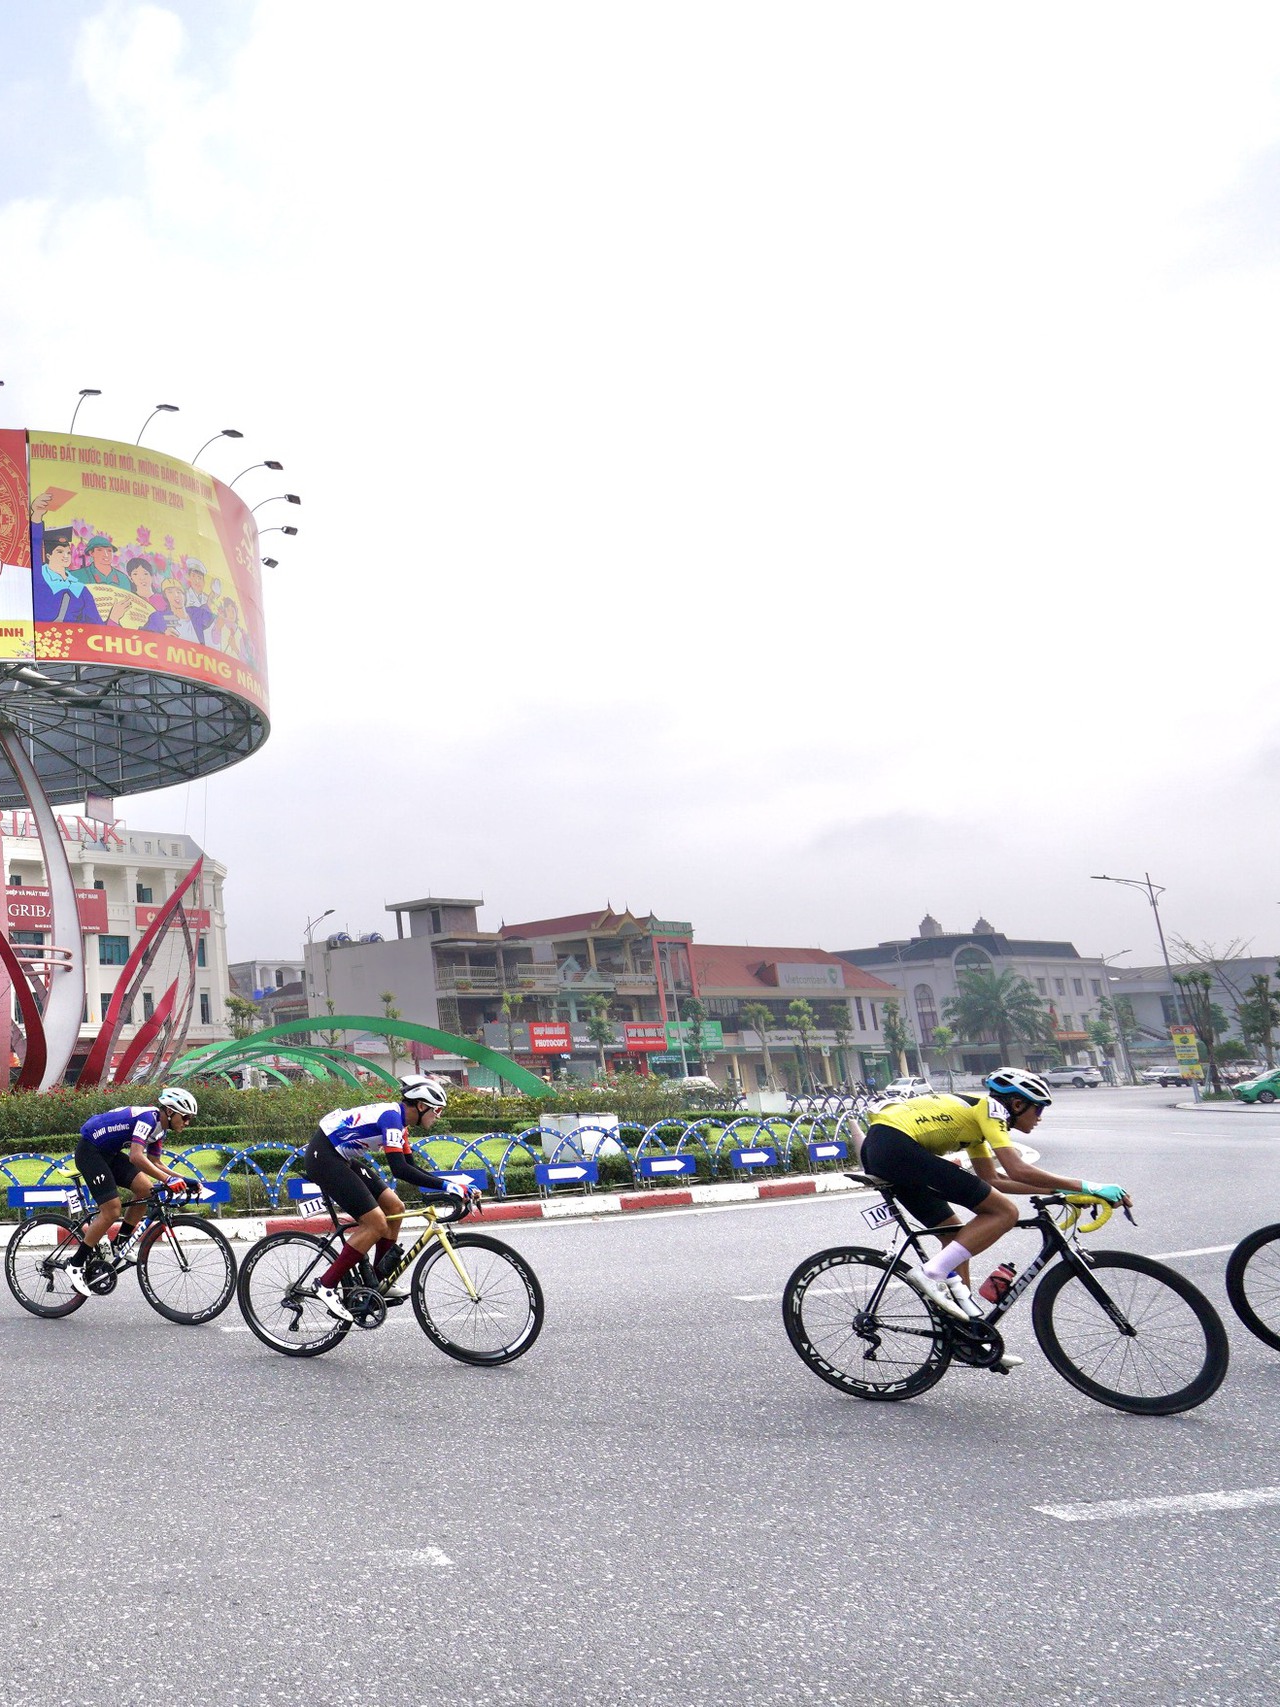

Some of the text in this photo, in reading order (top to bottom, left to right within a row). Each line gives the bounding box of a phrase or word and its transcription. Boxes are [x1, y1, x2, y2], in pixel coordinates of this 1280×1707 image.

[31, 441, 58, 459] MỪNG
[60, 442, 76, 462] ĐẤT
[78, 446, 101, 465] NƯỚC
[103, 448, 117, 468] ĐỔI
[81, 469, 107, 489] MỪNG
[109, 475, 131, 495] XUÂN
[86, 634, 158, 660] CHÚC
[167, 646, 232, 679] MỪNG
[236, 668, 262, 698] NĂM
[784, 973, 827, 985] Vietcombank
[535, 1038, 568, 1048] PHOTOCOPY
[135, 1123, 149, 1136] 131
[915, 1113, 954, 1126] HÀ NỘI
[69, 1194, 80, 1209] 131
[120, 1219, 149, 1258] GIANT
[792, 1254, 867, 1315] EASTON
